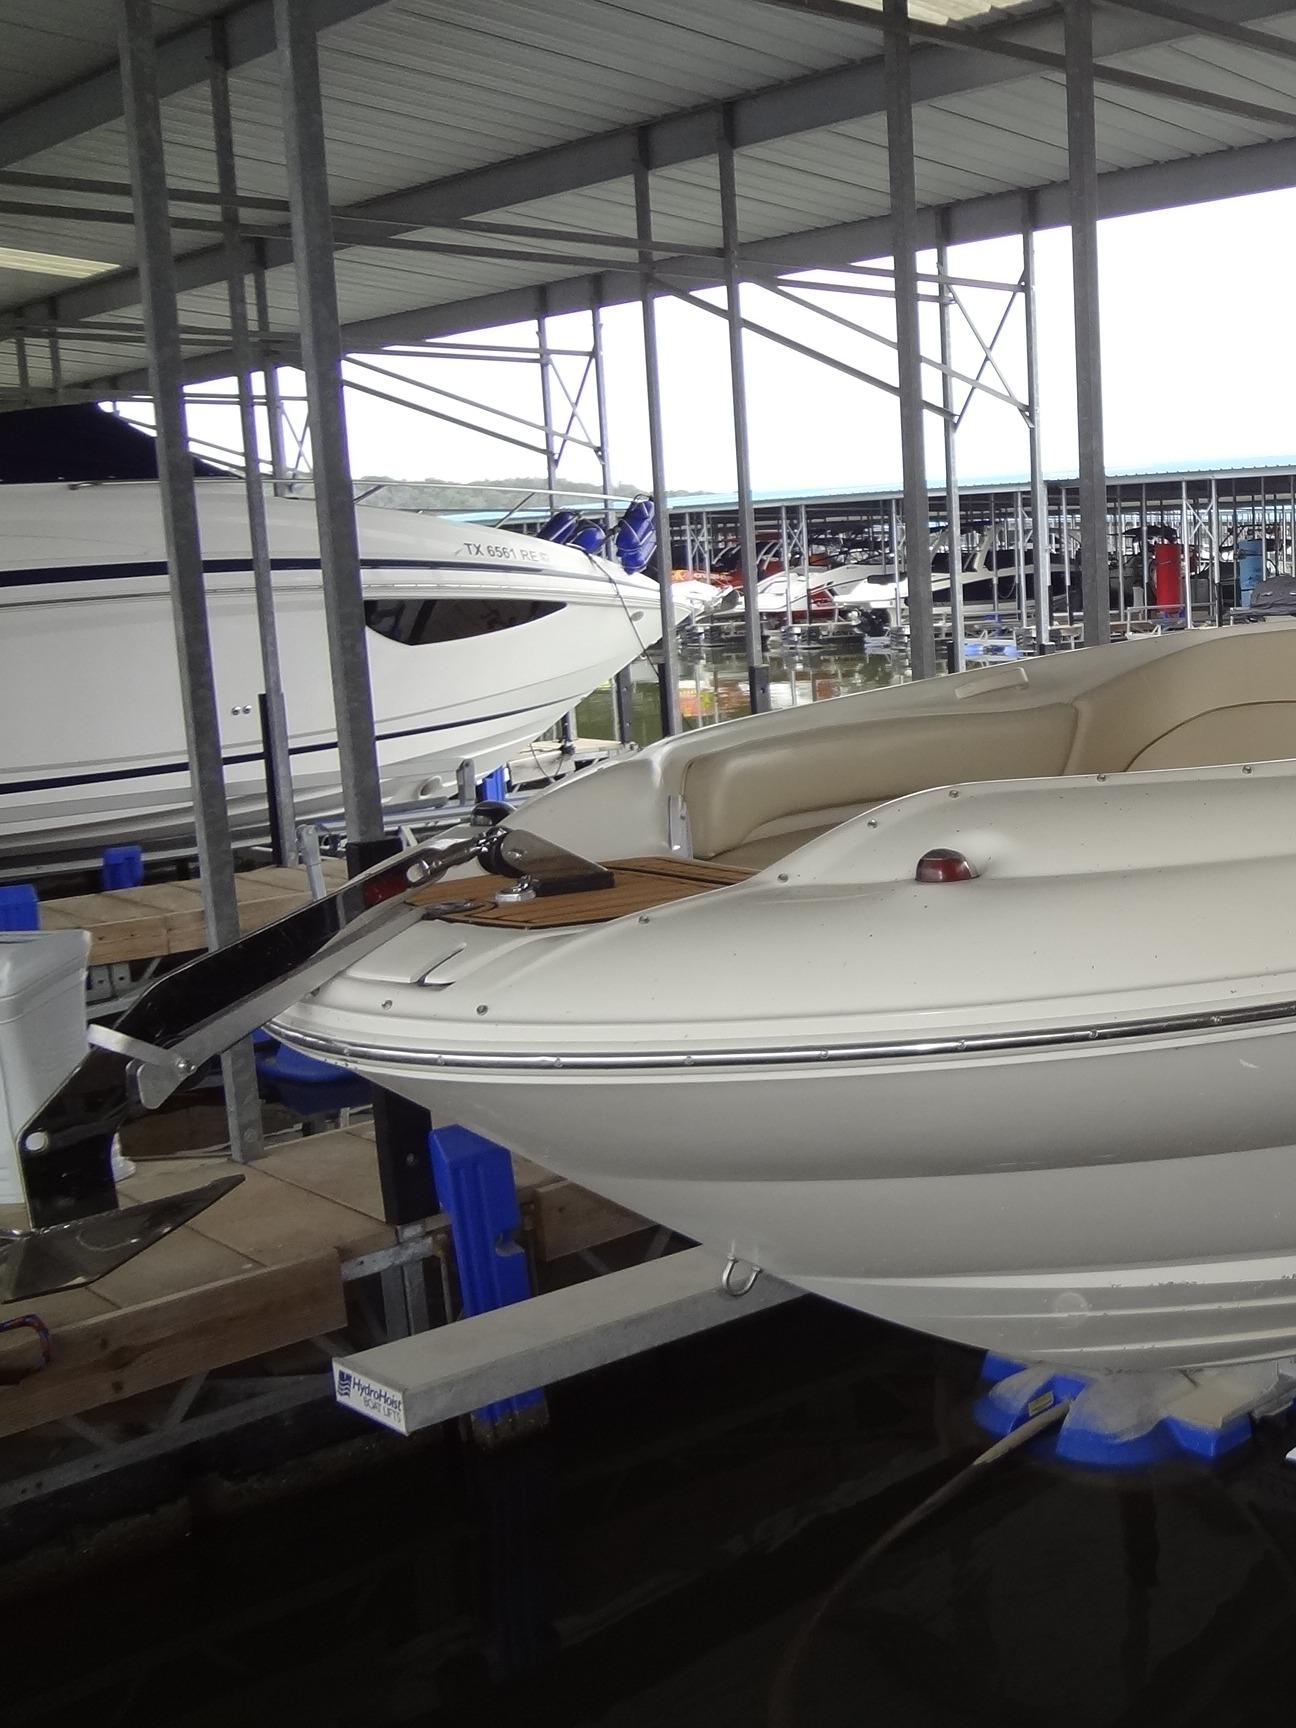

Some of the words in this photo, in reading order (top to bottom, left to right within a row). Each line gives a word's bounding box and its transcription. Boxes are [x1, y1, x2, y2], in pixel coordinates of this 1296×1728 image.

[463, 542, 485, 557] TX
[486, 545, 518, 559] 6561
[353, 1376, 402, 1412] HydroHoist
[363, 1396, 381, 1413] BOAT
[383, 1405, 402, 1423] LIFTS
